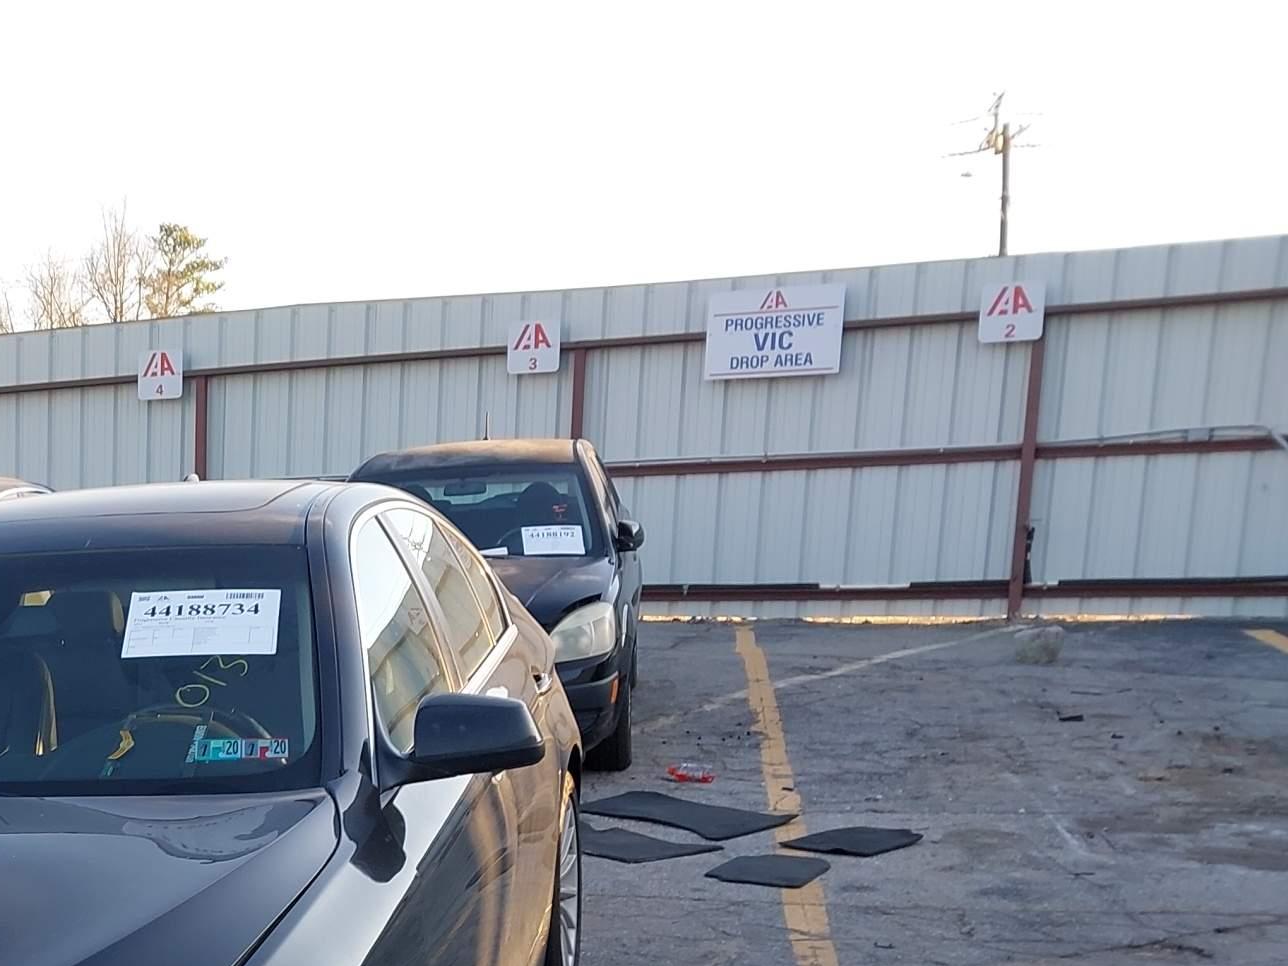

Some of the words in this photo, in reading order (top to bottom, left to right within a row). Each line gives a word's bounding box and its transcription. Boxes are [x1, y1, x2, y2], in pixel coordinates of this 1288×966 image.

[724, 311, 826, 333] PROGRESSIVE
[1004, 324, 1016, 338] 2
[754, 331, 794, 351] VIC
[528, 356, 538, 370] 3
[730, 354, 770, 370] DROP
[774, 351, 814, 368] AREA
[155, 384, 164, 395] 4
[143, 602, 261, 618] 44188734
